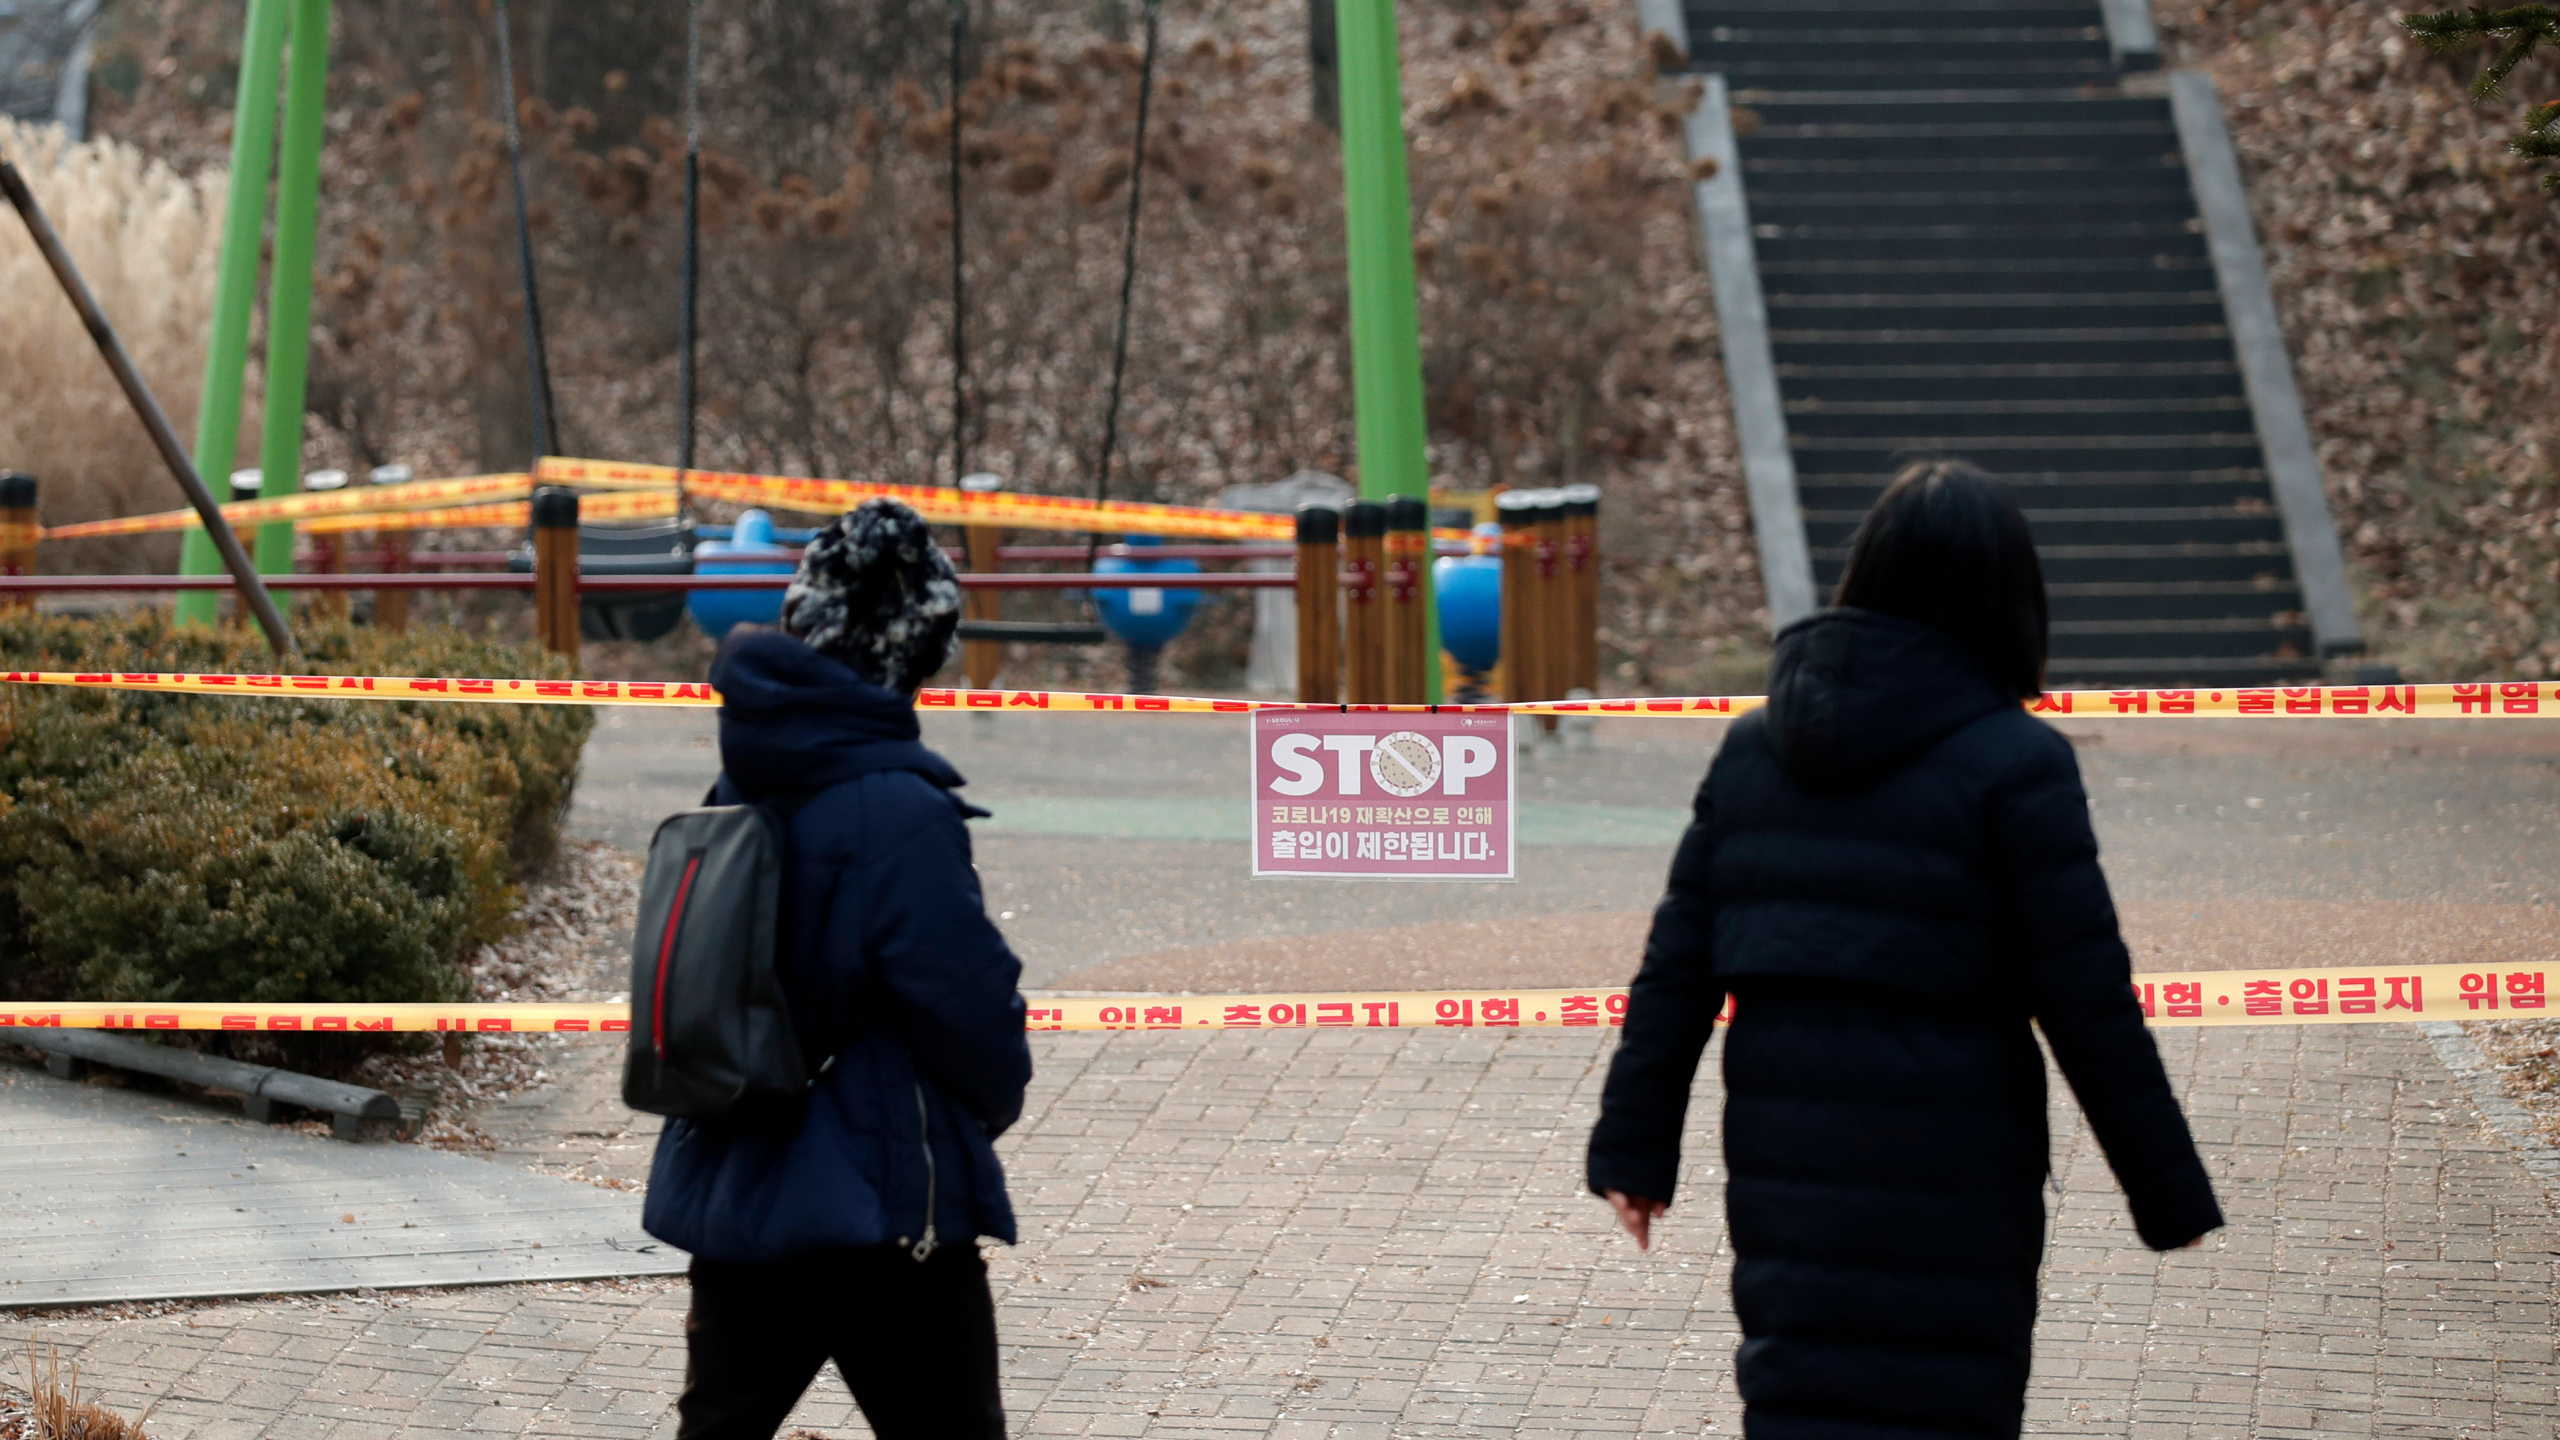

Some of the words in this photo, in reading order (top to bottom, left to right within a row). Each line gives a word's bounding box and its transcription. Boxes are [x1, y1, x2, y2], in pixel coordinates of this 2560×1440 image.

[1269, 731, 1498, 797] STOP
[1271, 806, 1351, 825] 코로나19
[1356, 807, 1450, 825] 재확산으로
[1457, 807, 1493, 825] 인해
[1271, 829, 1349, 860] 출입이
[1356, 831, 1495, 861] 제한됩니다.
[2459, 972, 2545, 1010] 위험
